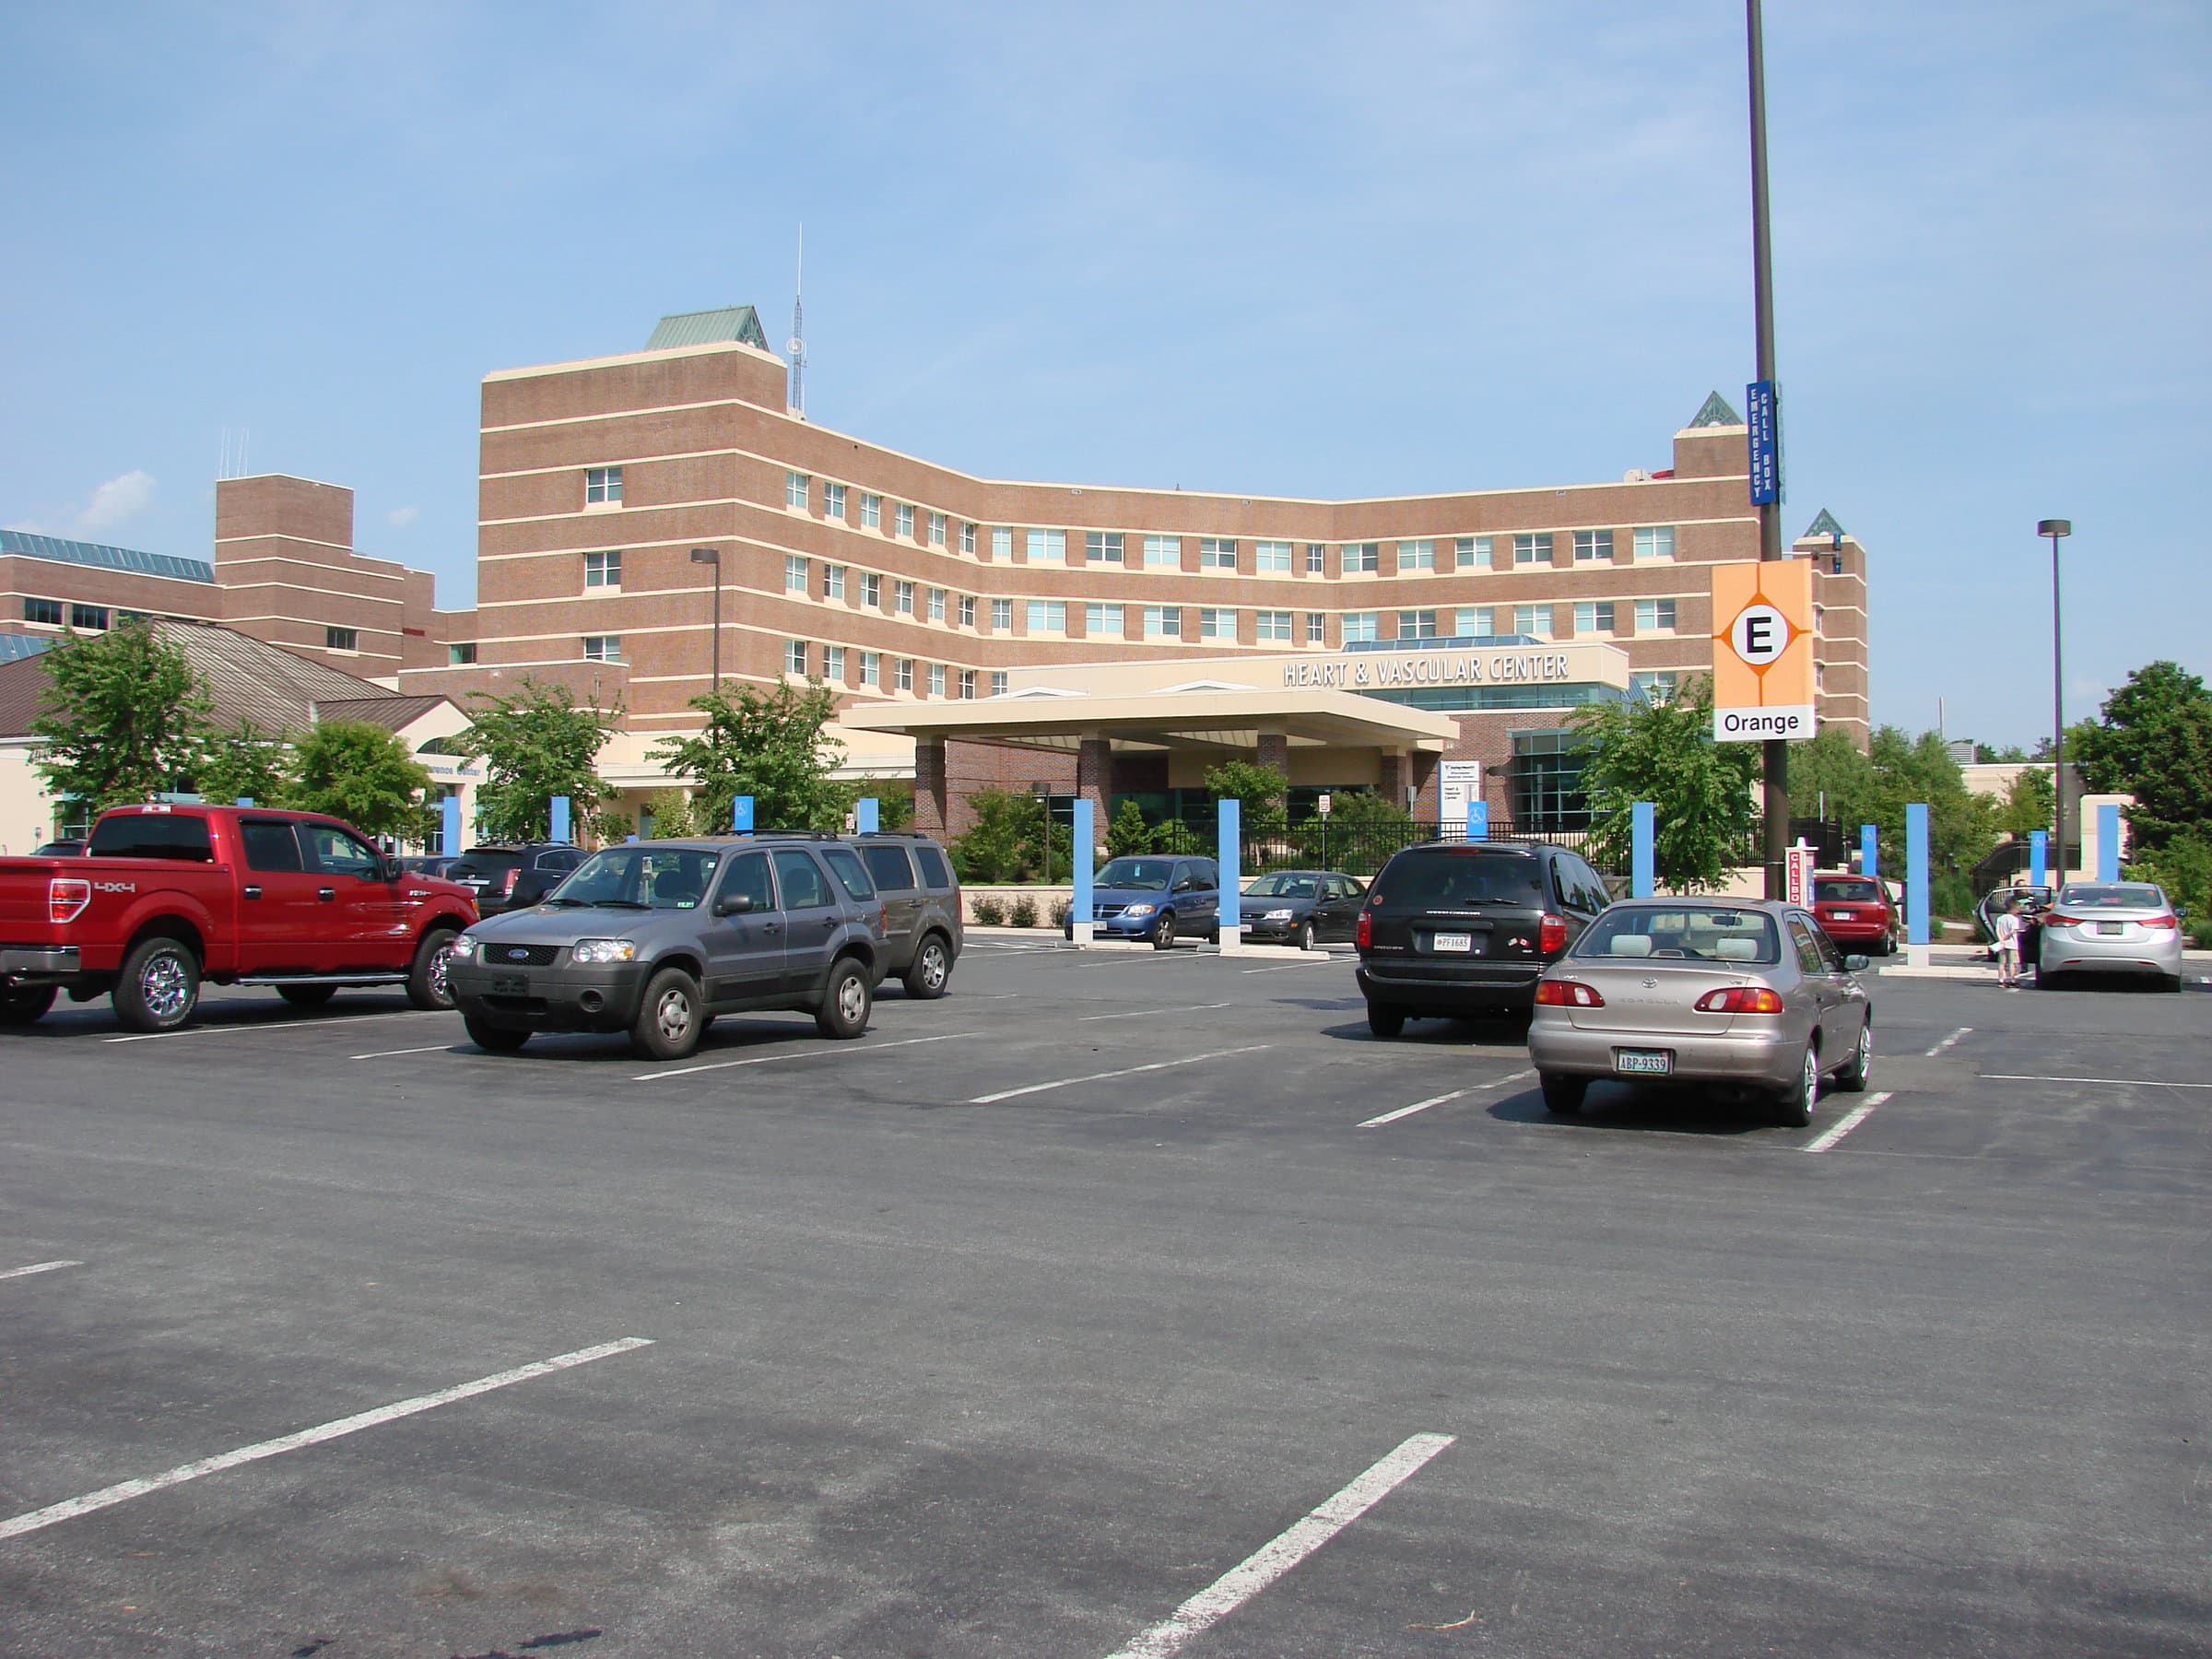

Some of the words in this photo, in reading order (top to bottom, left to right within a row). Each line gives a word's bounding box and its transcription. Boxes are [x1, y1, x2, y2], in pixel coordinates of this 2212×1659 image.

[1760, 393, 1770, 441] CALL
[1750, 388, 1761, 498] EMERGENCY
[1763, 454, 1771, 491] BOX
[1747, 616, 1773, 653] E
[1284, 661, 1347, 688] HEART
[1355, 661, 1371, 684] &
[1378, 655, 1484, 683] VASCULAR
[1489, 653, 1571, 680] CENTER
[1724, 713, 1799, 735] Orange
[1621, 1055, 1666, 1071] ABP-9339
